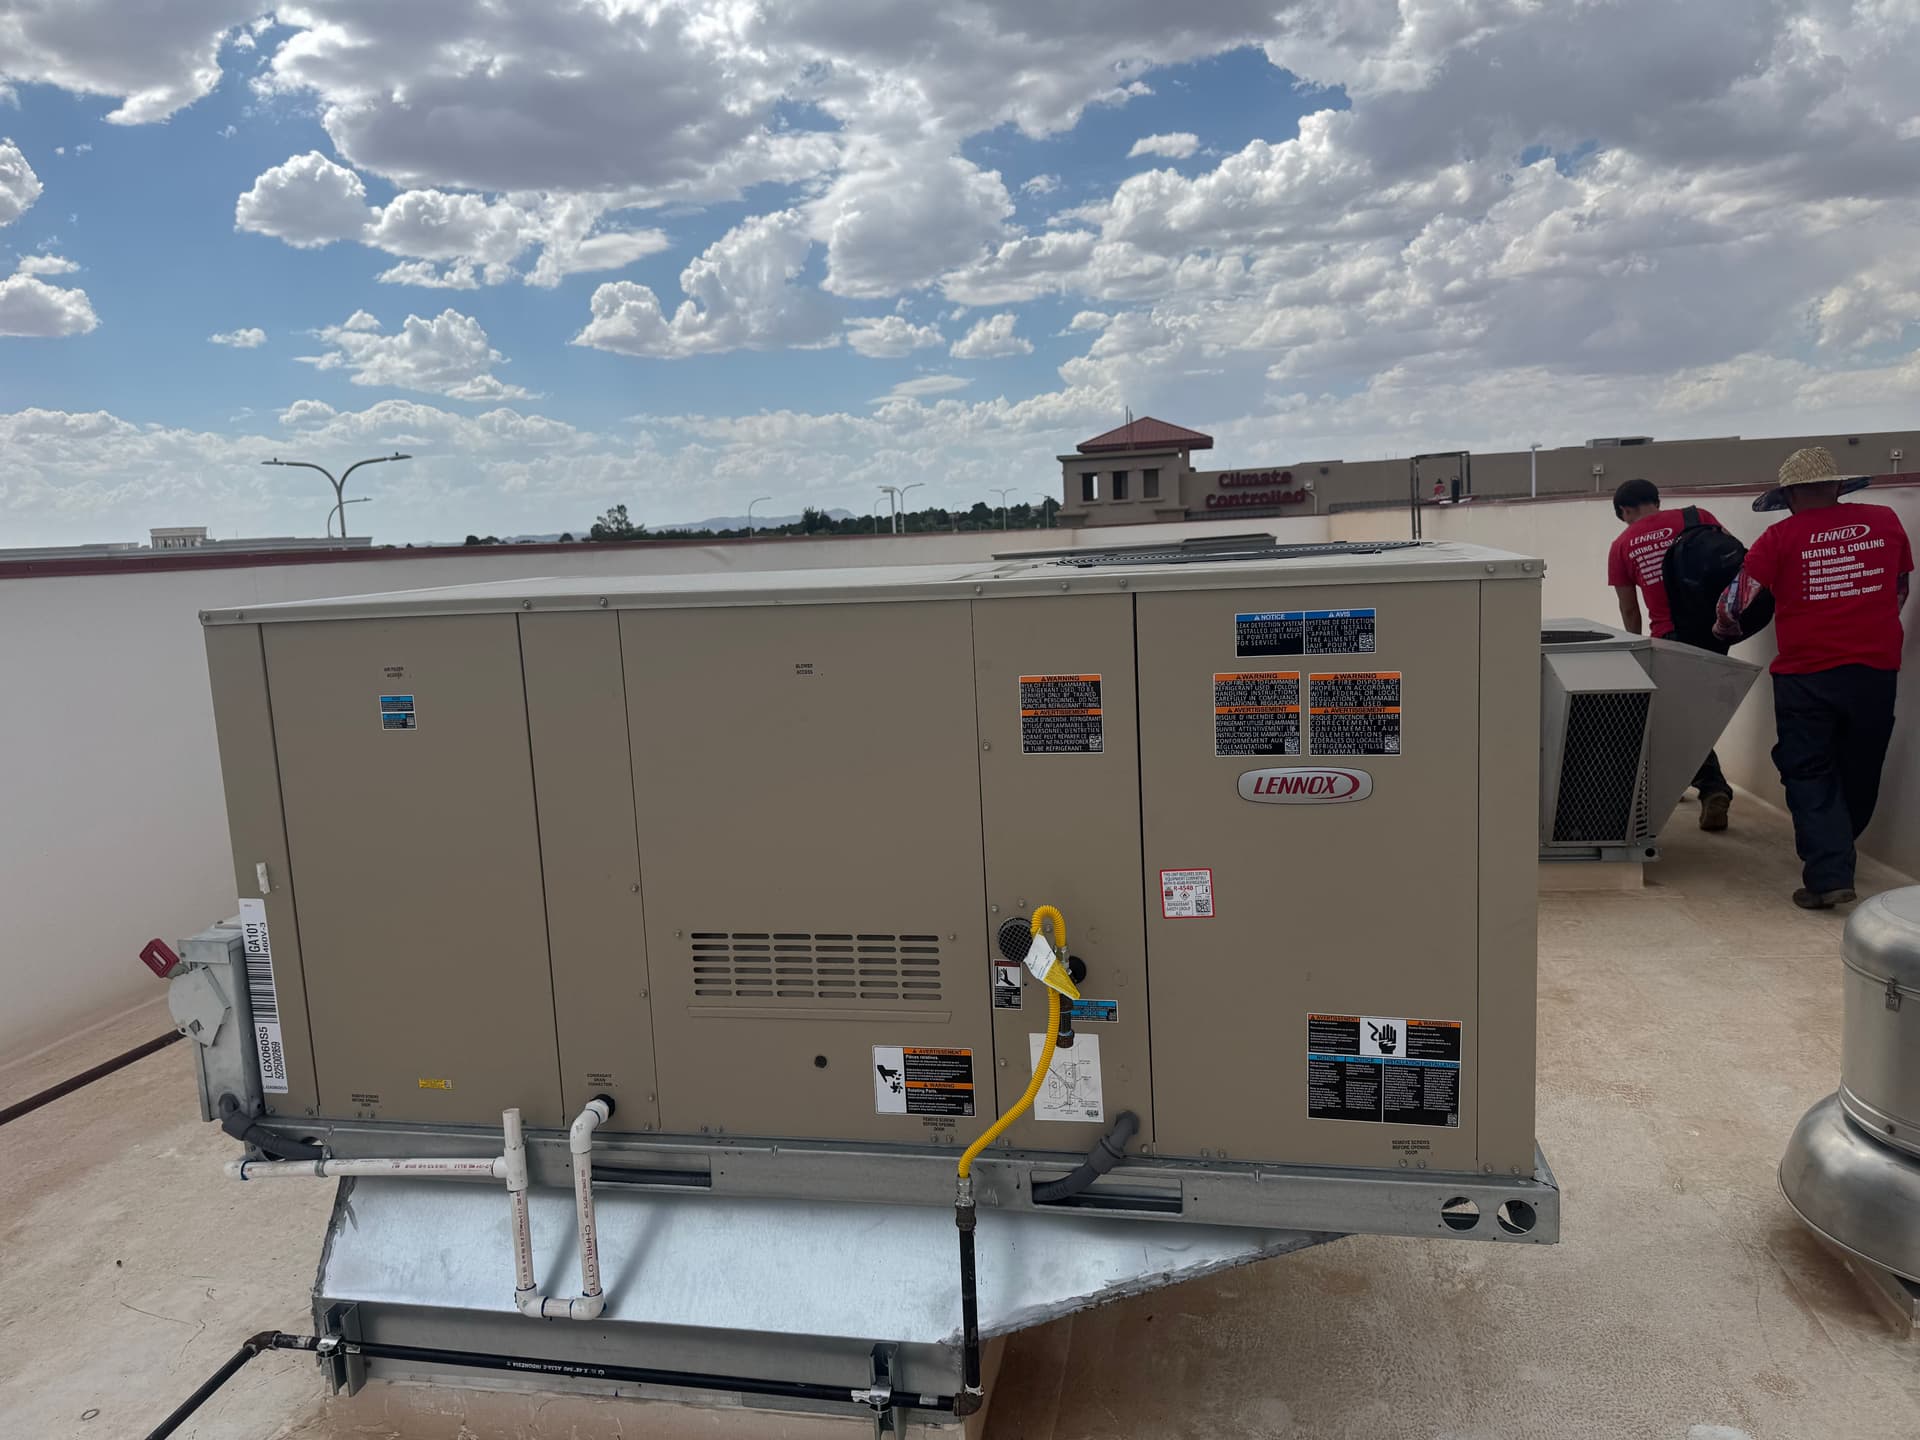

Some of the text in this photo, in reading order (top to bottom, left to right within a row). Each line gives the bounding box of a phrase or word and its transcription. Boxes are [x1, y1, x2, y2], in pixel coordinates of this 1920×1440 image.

[1218, 471, 1293, 489] Climate
[1206, 488, 1306, 509] Controlled
[1630, 531, 1666, 547] LENNOX
[1810, 527, 1858, 543] LENNOX
[1802, 539, 1885, 560] HEATING & COOLING
[1253, 776, 1339, 795] LENNOX
[245, 924, 260, 952] GA101
[260, 922, 269, 952] 460V-3
[259, 1026, 273, 1078] LGX060S5
[585, 1224, 596, 1297] CHARLOTTE
